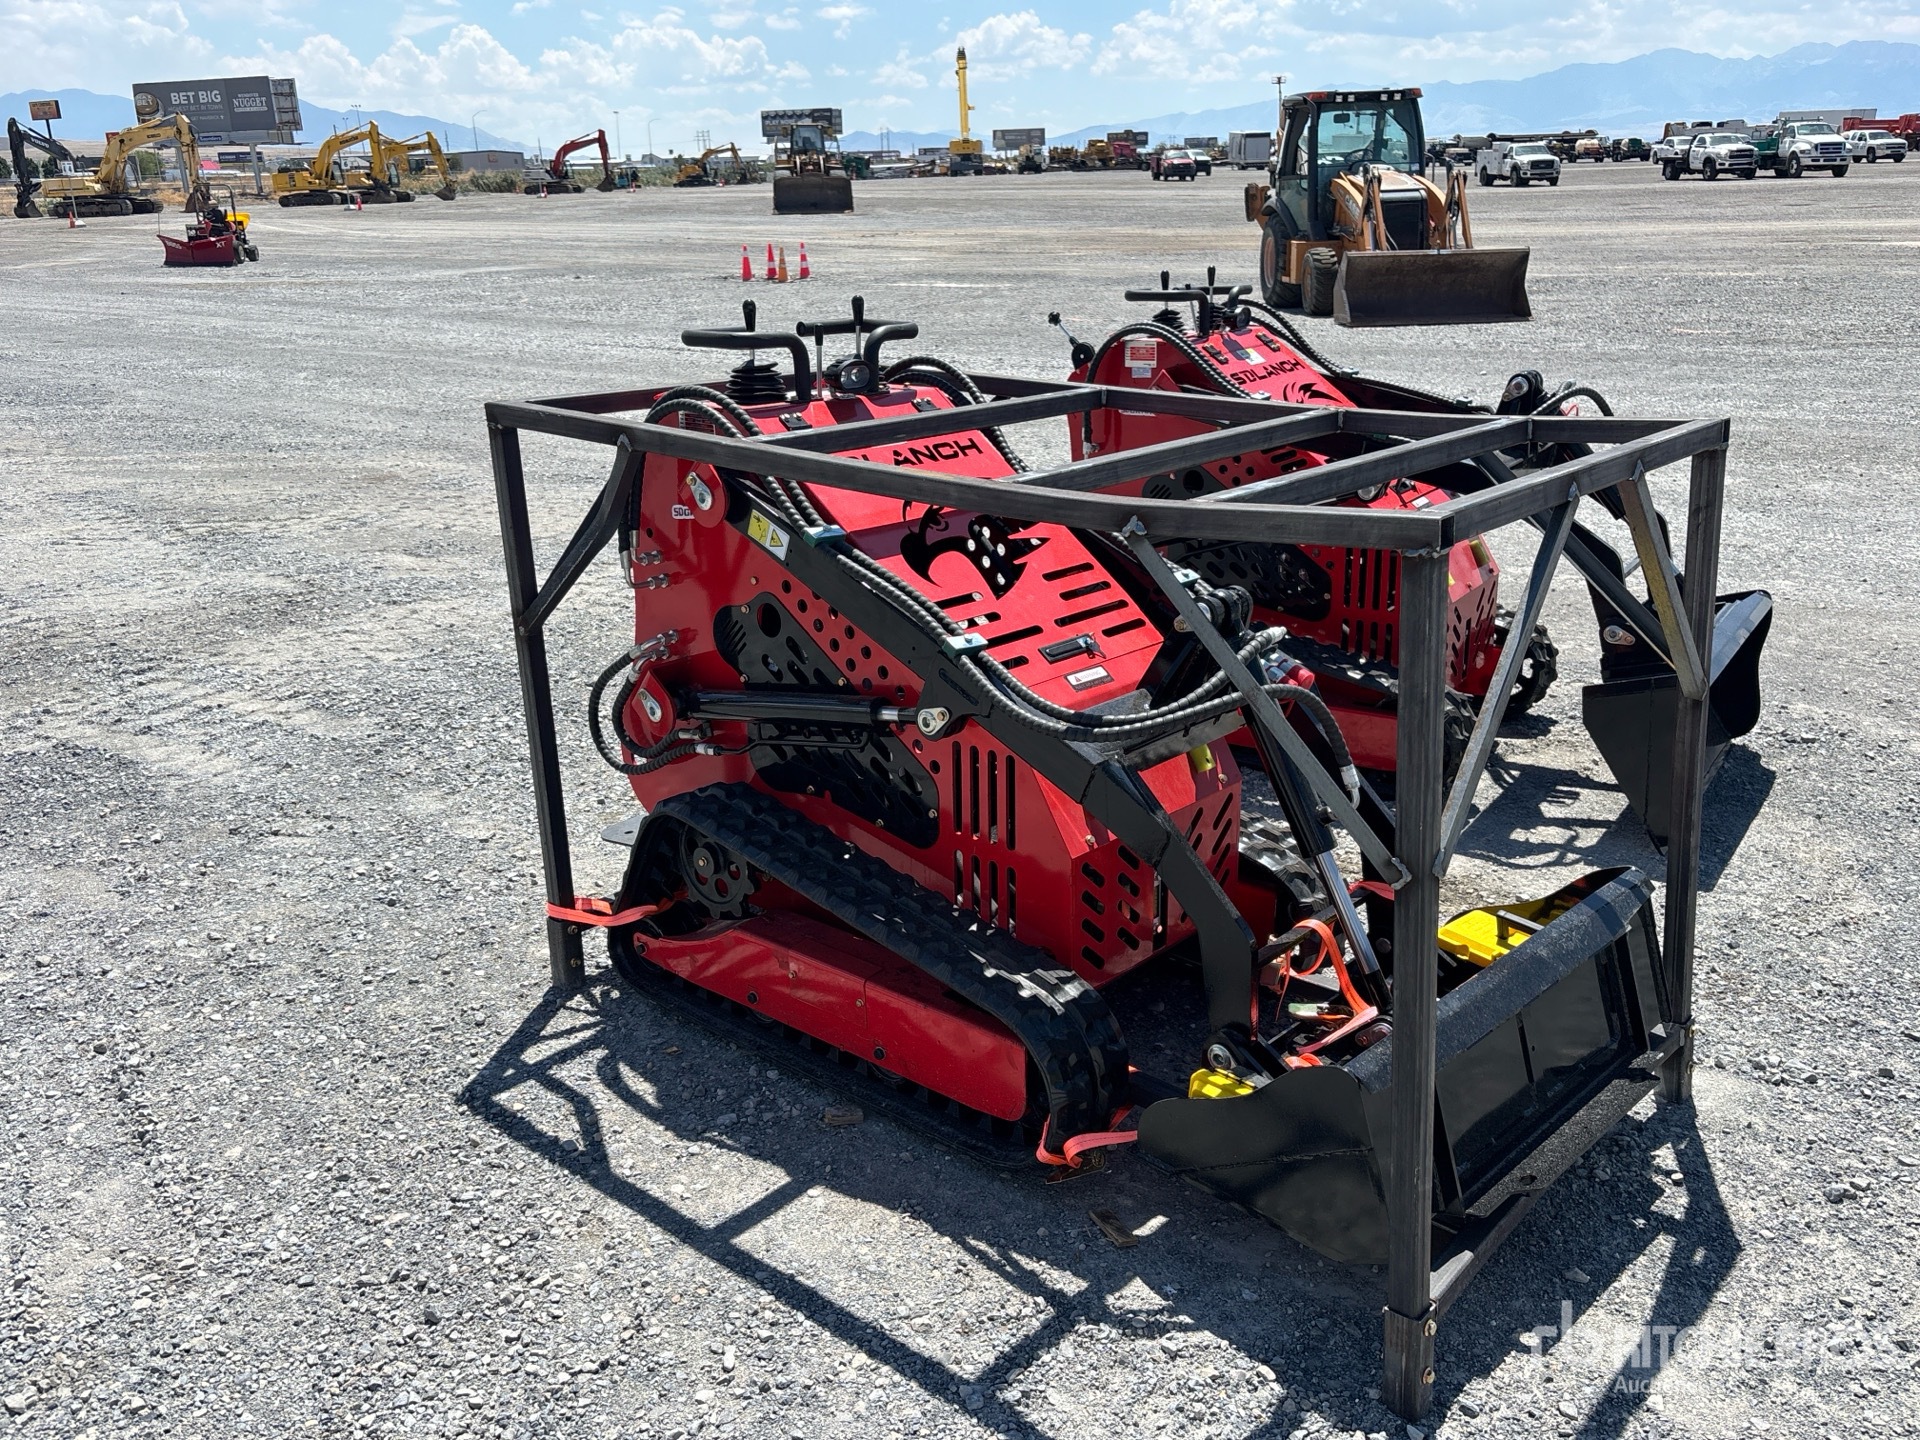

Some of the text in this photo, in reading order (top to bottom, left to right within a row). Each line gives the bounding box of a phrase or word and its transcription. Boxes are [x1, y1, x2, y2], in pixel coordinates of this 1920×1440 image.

[170, 90, 221, 104] BET BIG
[232, 97, 266, 107] NUGGET
[31, 138, 49, 148] VOLVO
[1230, 357, 1306, 386] SDLANCH
